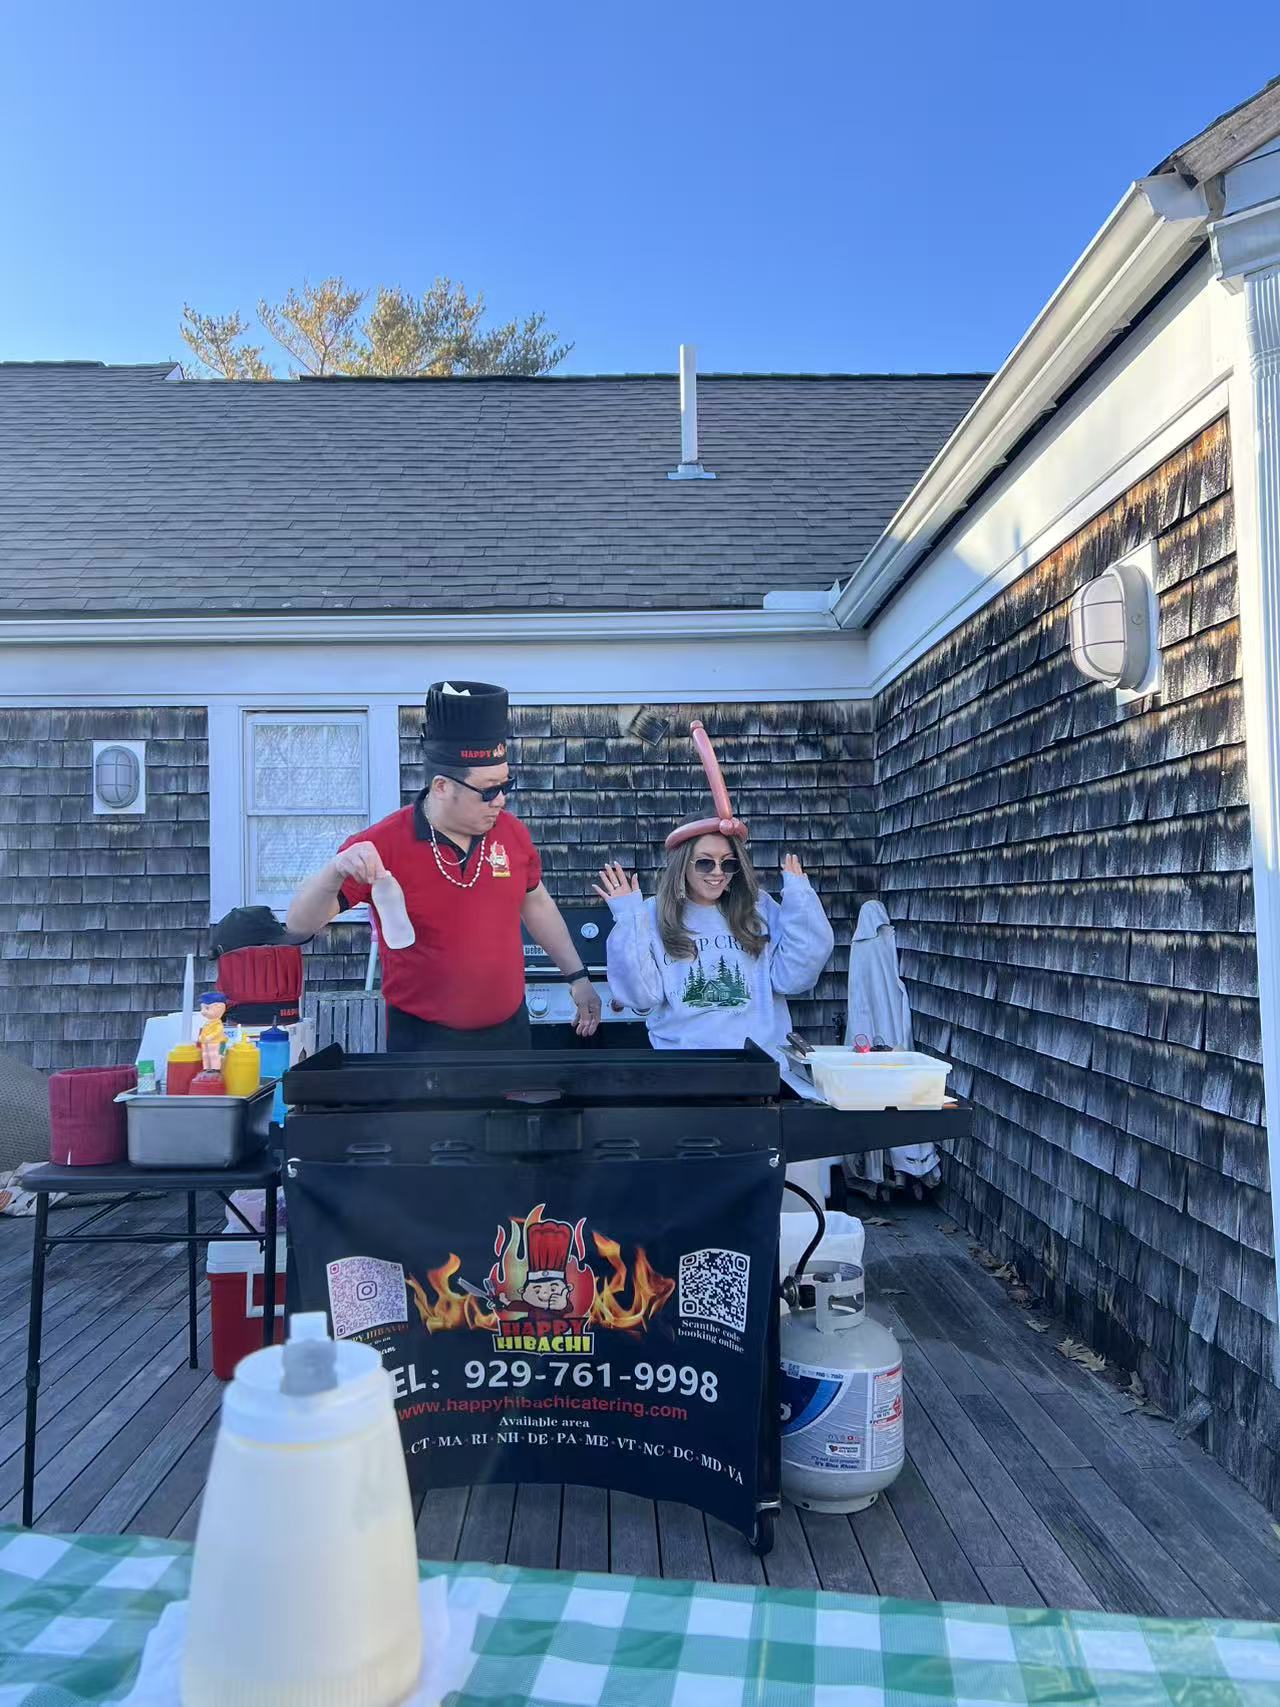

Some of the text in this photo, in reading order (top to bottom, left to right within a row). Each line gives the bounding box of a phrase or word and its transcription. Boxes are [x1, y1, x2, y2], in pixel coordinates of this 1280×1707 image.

[461, 750, 491, 759] HAPPY
[502, 1320, 583, 1336] HAPPY
[722, 1328, 741, 1342] code
[496, 1336, 591, 1352] HIBACHI
[677, 1328, 744, 1354] booking online
[388, 1360, 719, 1403] EL: 929-761-9998
[398, 1394, 689, 1421] www.happyhibachicatering.com
[498, 1416, 590, 1428] Available area
